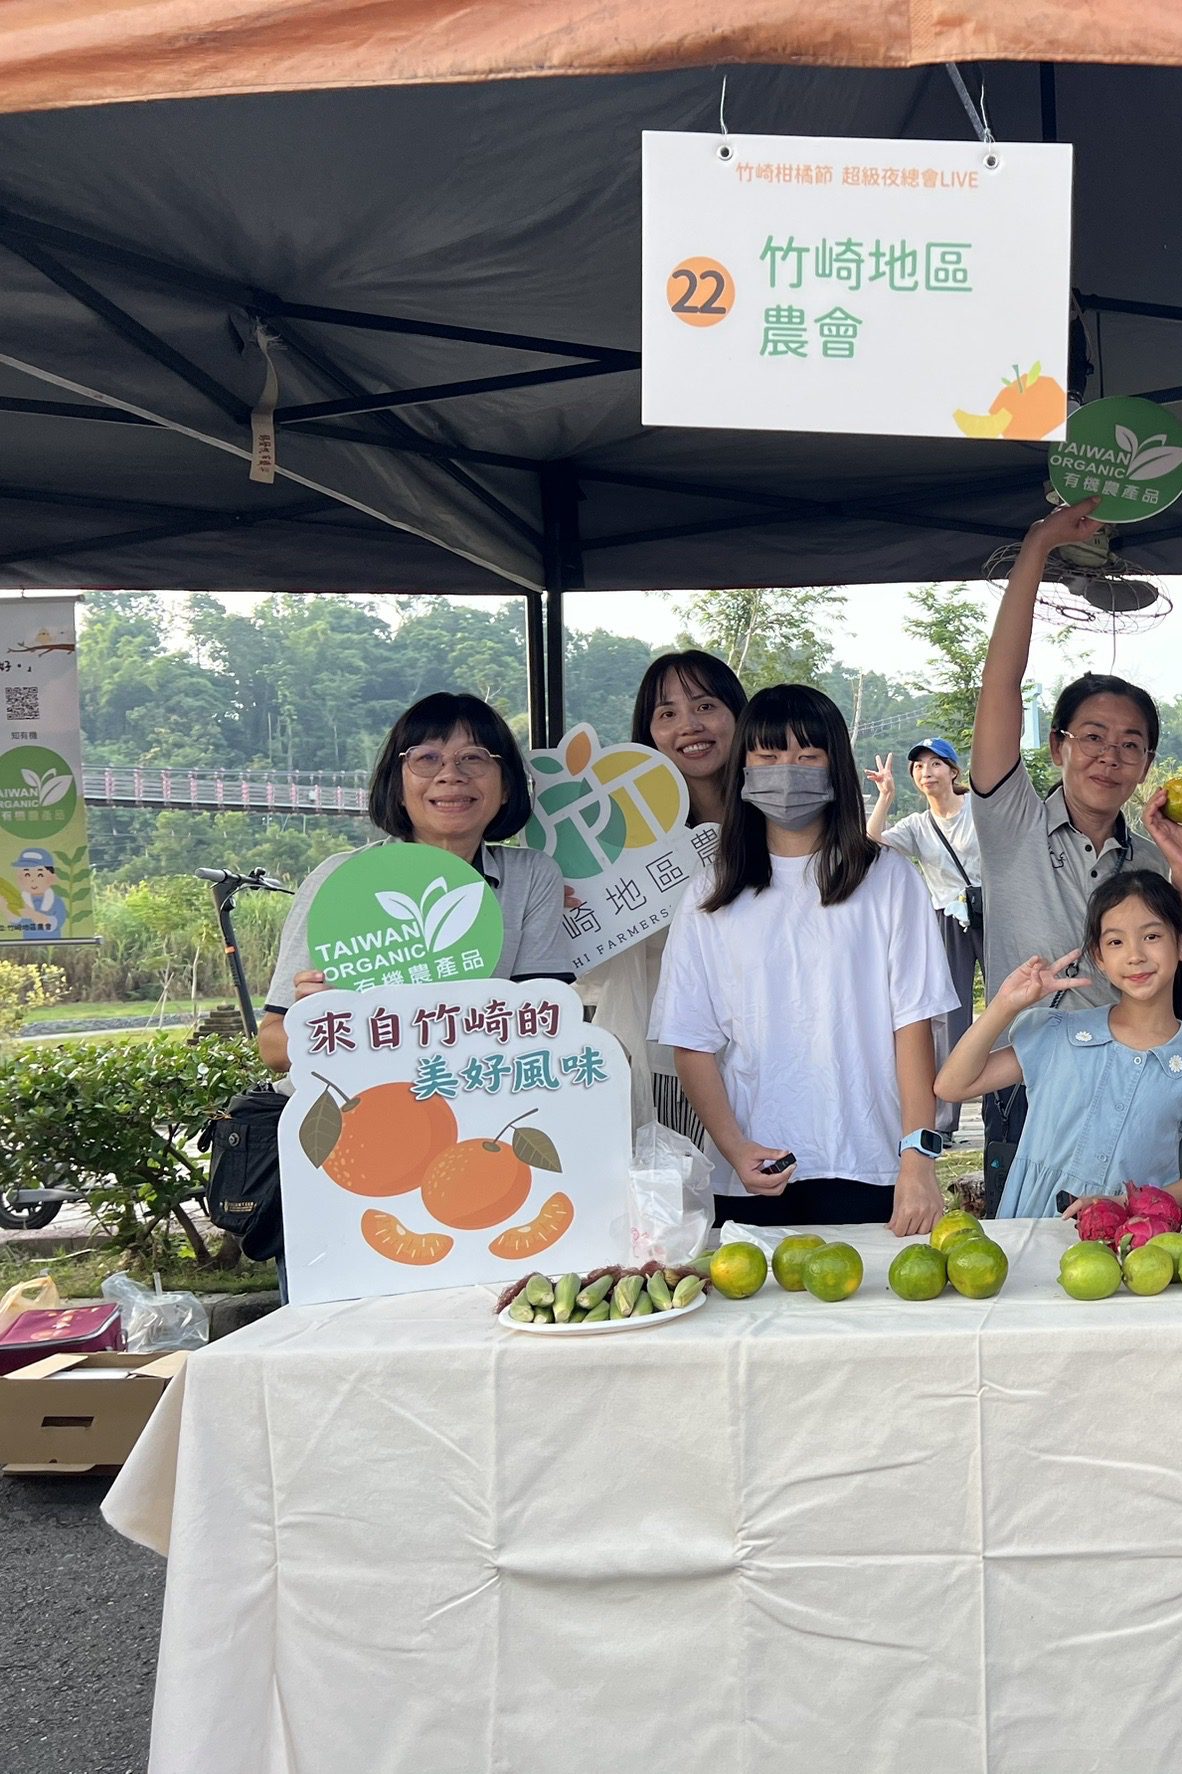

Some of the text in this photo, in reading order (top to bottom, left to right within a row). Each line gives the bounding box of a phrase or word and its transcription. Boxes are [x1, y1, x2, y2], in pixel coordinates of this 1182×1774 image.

[735, 161, 980, 189] 竹崎柑橘節 超級夜總會LIVE
[758, 234, 974, 293] 竹崎地區
[671, 268, 726, 314] 22
[758, 304, 864, 359] 農會
[1050, 454, 1127, 479] ORGANIC
[1057, 440, 1132, 466] TAIWAN
[1063, 471, 1160, 505] 有機農產品
[314, 921, 422, 963] TAIWAN
[323, 943, 427, 982] ORGANIC
[304, 999, 562, 1056] 來自竹崎的
[408, 1045, 610, 1102] 美好風味
